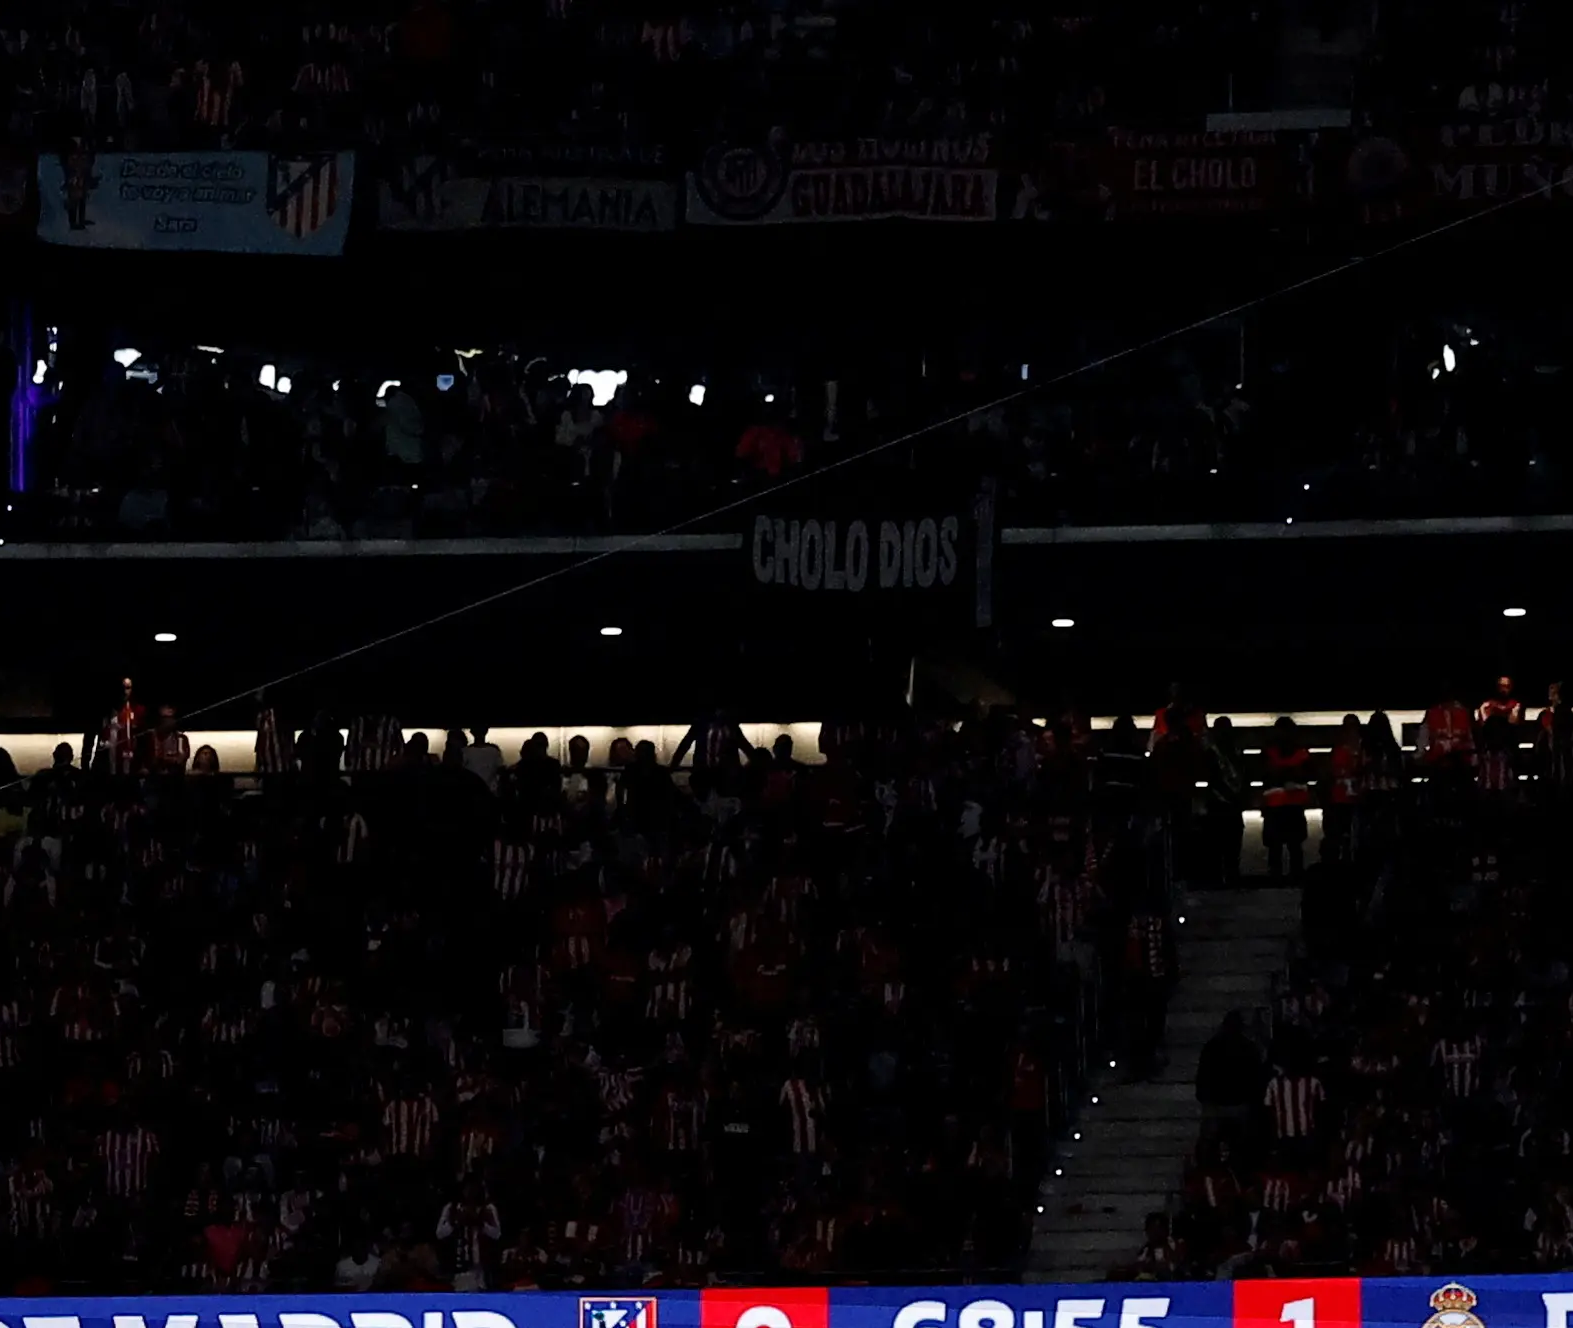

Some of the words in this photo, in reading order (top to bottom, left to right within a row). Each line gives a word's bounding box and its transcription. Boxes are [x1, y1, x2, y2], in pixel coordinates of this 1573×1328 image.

[1133, 158, 1163, 190] EL
[1172, 157, 1257, 189] CHOLO
[752, 515, 869, 592] CHOLO
[879, 515, 958, 588] DIOS
